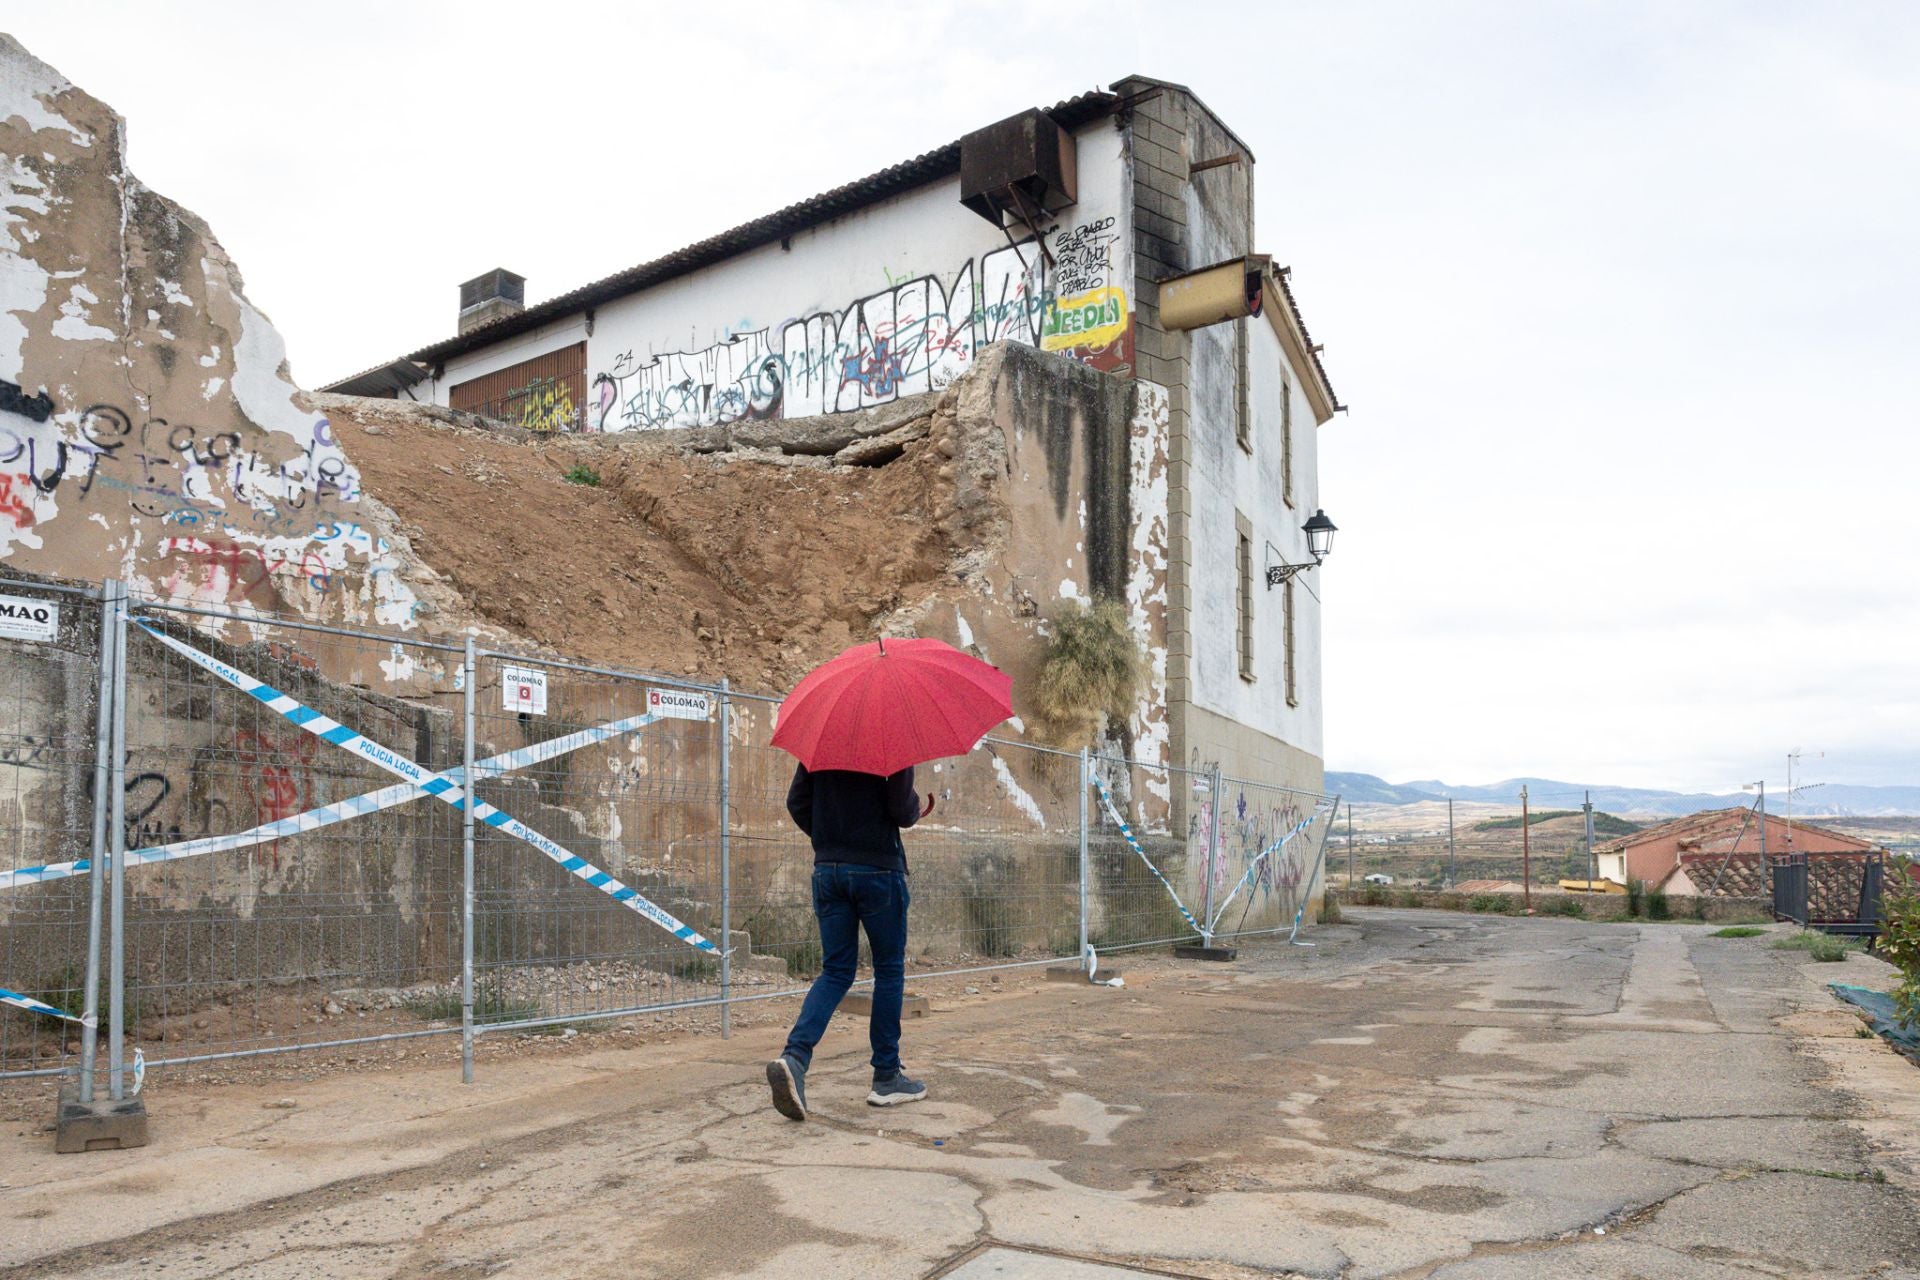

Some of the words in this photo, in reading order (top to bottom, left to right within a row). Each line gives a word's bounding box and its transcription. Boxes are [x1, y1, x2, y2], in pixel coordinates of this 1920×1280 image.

[507, 674, 543, 686] COLOMAQ
[661, 695, 706, 711] COLOMAQ
[360, 740, 393, 766] POLICIA
[394, 759, 420, 780] LOCAL
